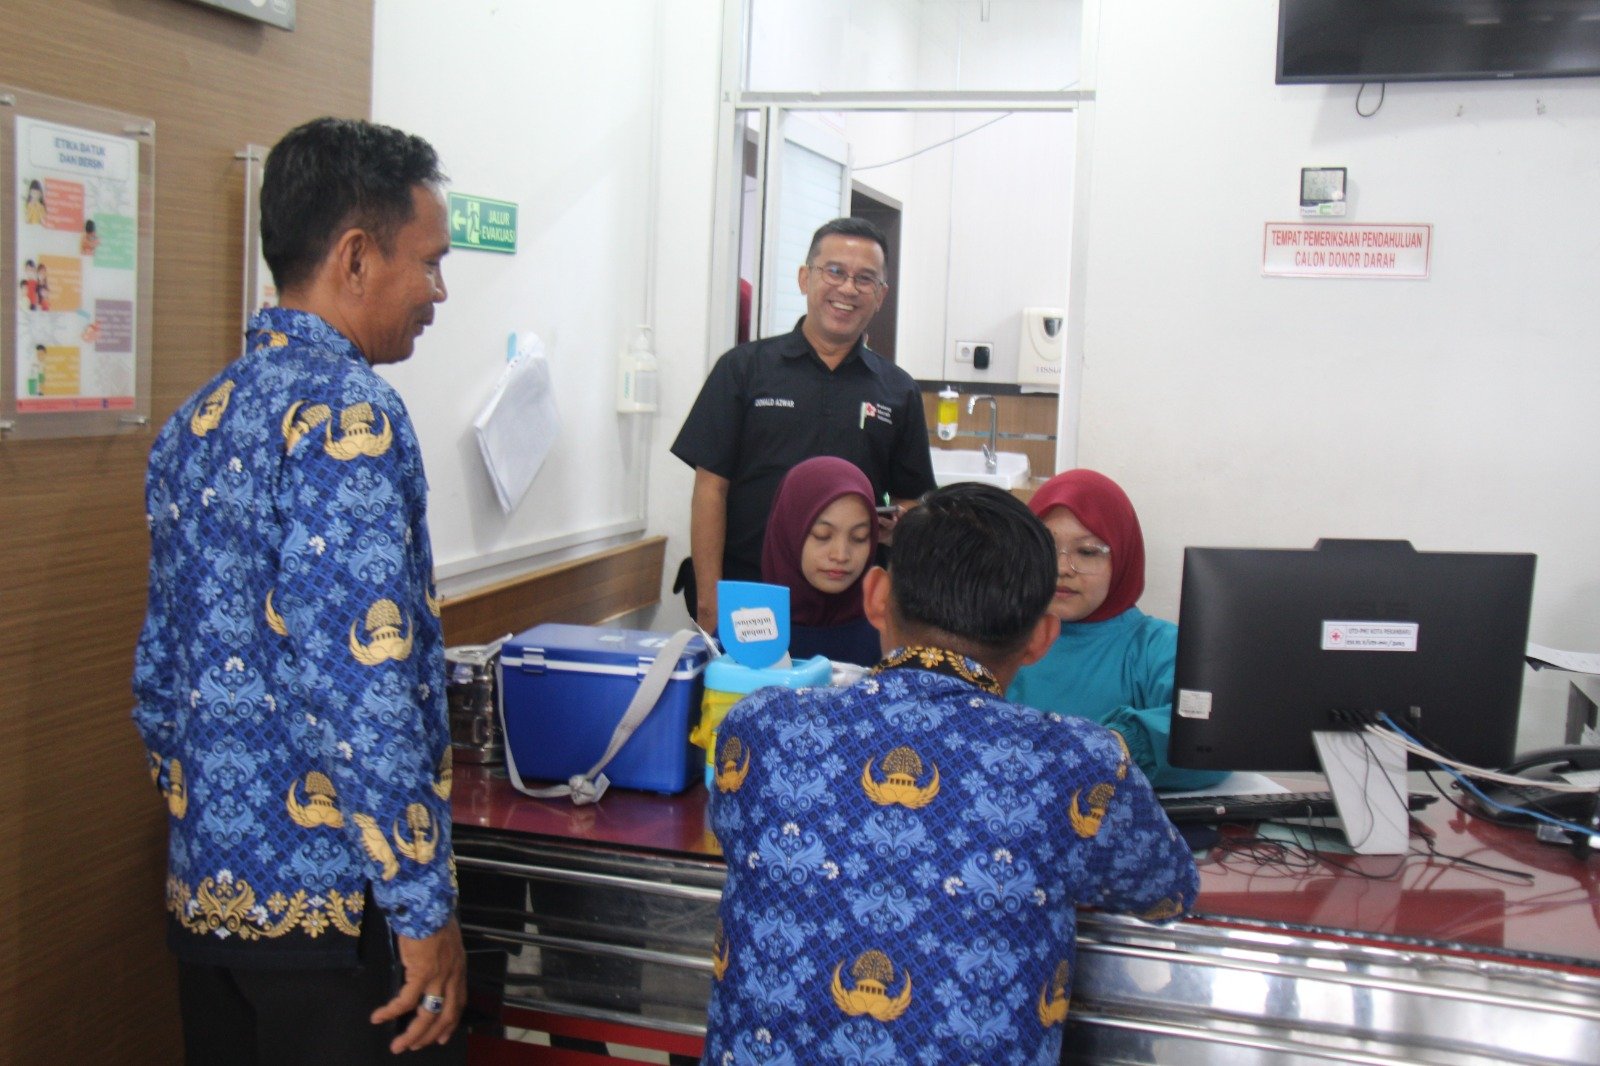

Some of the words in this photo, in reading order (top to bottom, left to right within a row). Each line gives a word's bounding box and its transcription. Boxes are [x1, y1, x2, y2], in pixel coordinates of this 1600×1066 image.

[55, 137, 79, 151] ETIKA
[59, 152, 78, 165] DAN
[79, 156, 105, 170] BERSIN
[488, 209, 510, 226] JALUR
[1272, 230, 1302, 246] TEMPAT
[1303, 231, 1360, 247] PEMERIKSAAN
[1362, 232, 1423, 249] PENDAHULUAN
[1295, 251, 1326, 267] CALON
[1328, 251, 1361, 268] DONOR
[1363, 252, 1396, 269] DARAH
[1035, 365, 1061, 374] TISSU
[775, 398, 795, 408] AZWAR
